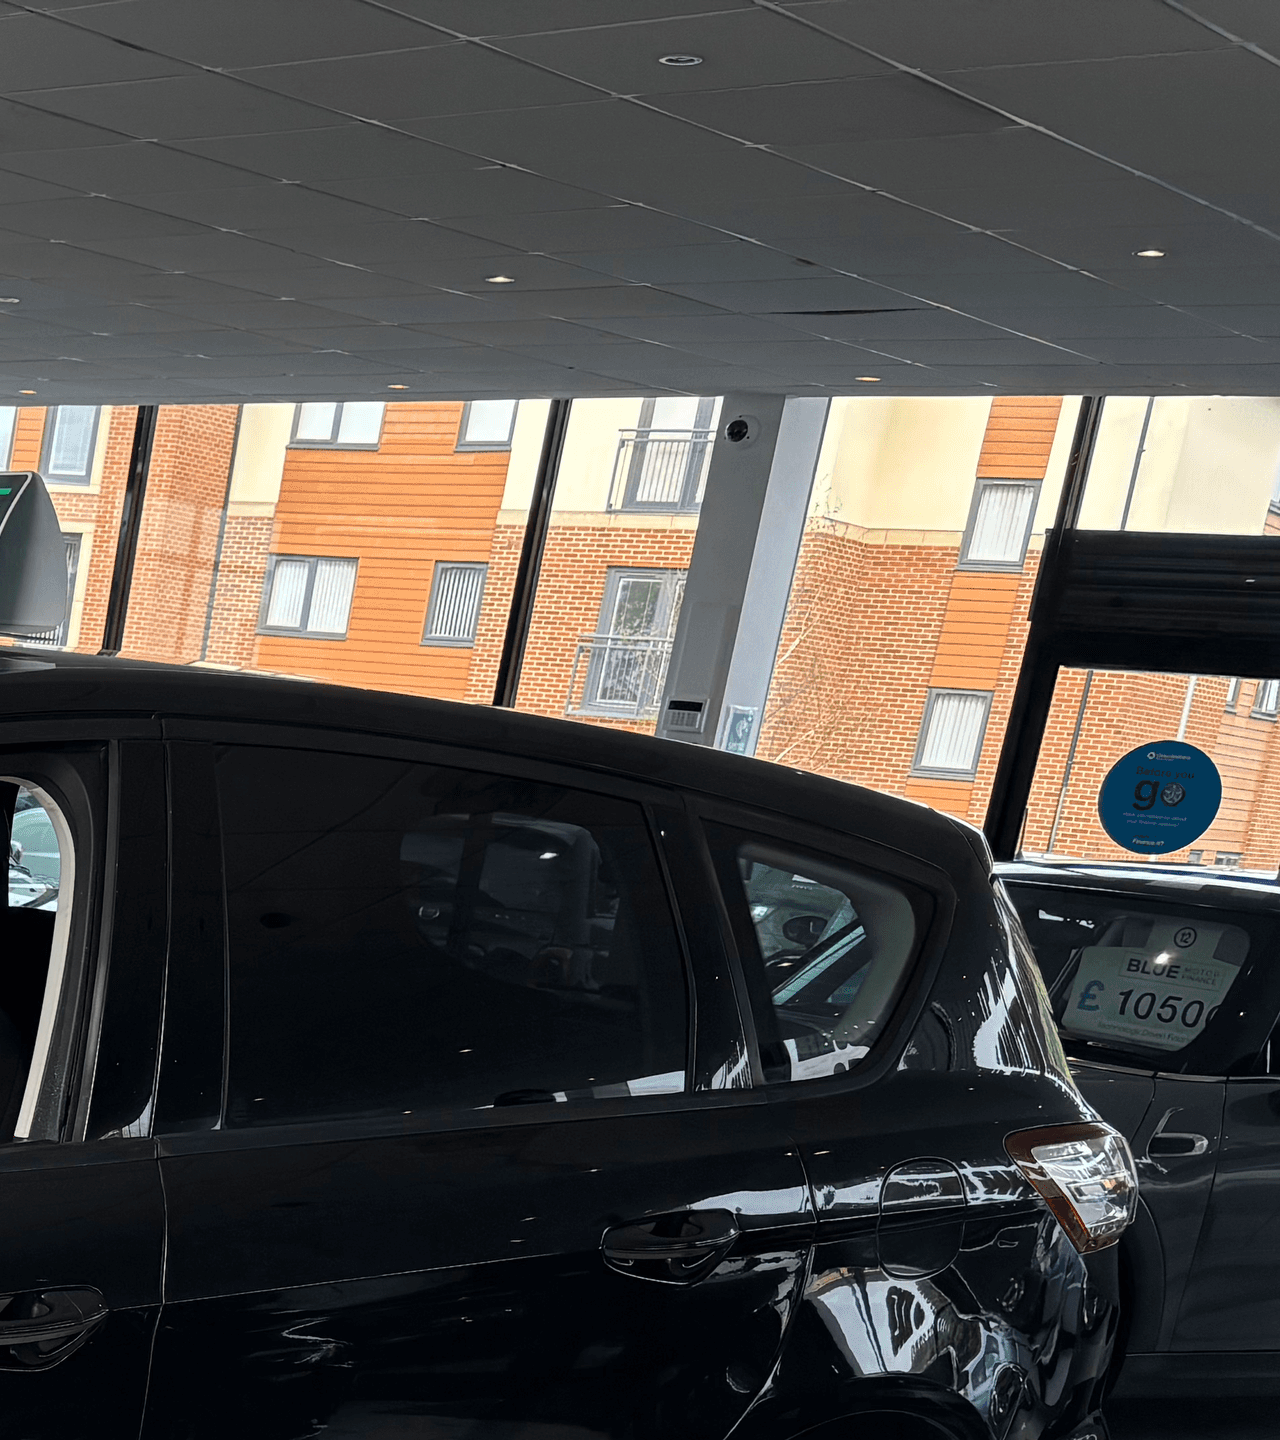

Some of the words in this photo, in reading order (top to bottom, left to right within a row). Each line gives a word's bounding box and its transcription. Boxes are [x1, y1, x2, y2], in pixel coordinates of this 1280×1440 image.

[1173, 770, 1195, 780] you
[1179, 932, 1192, 944] 12
[1126, 957, 1181, 979] BLUE
